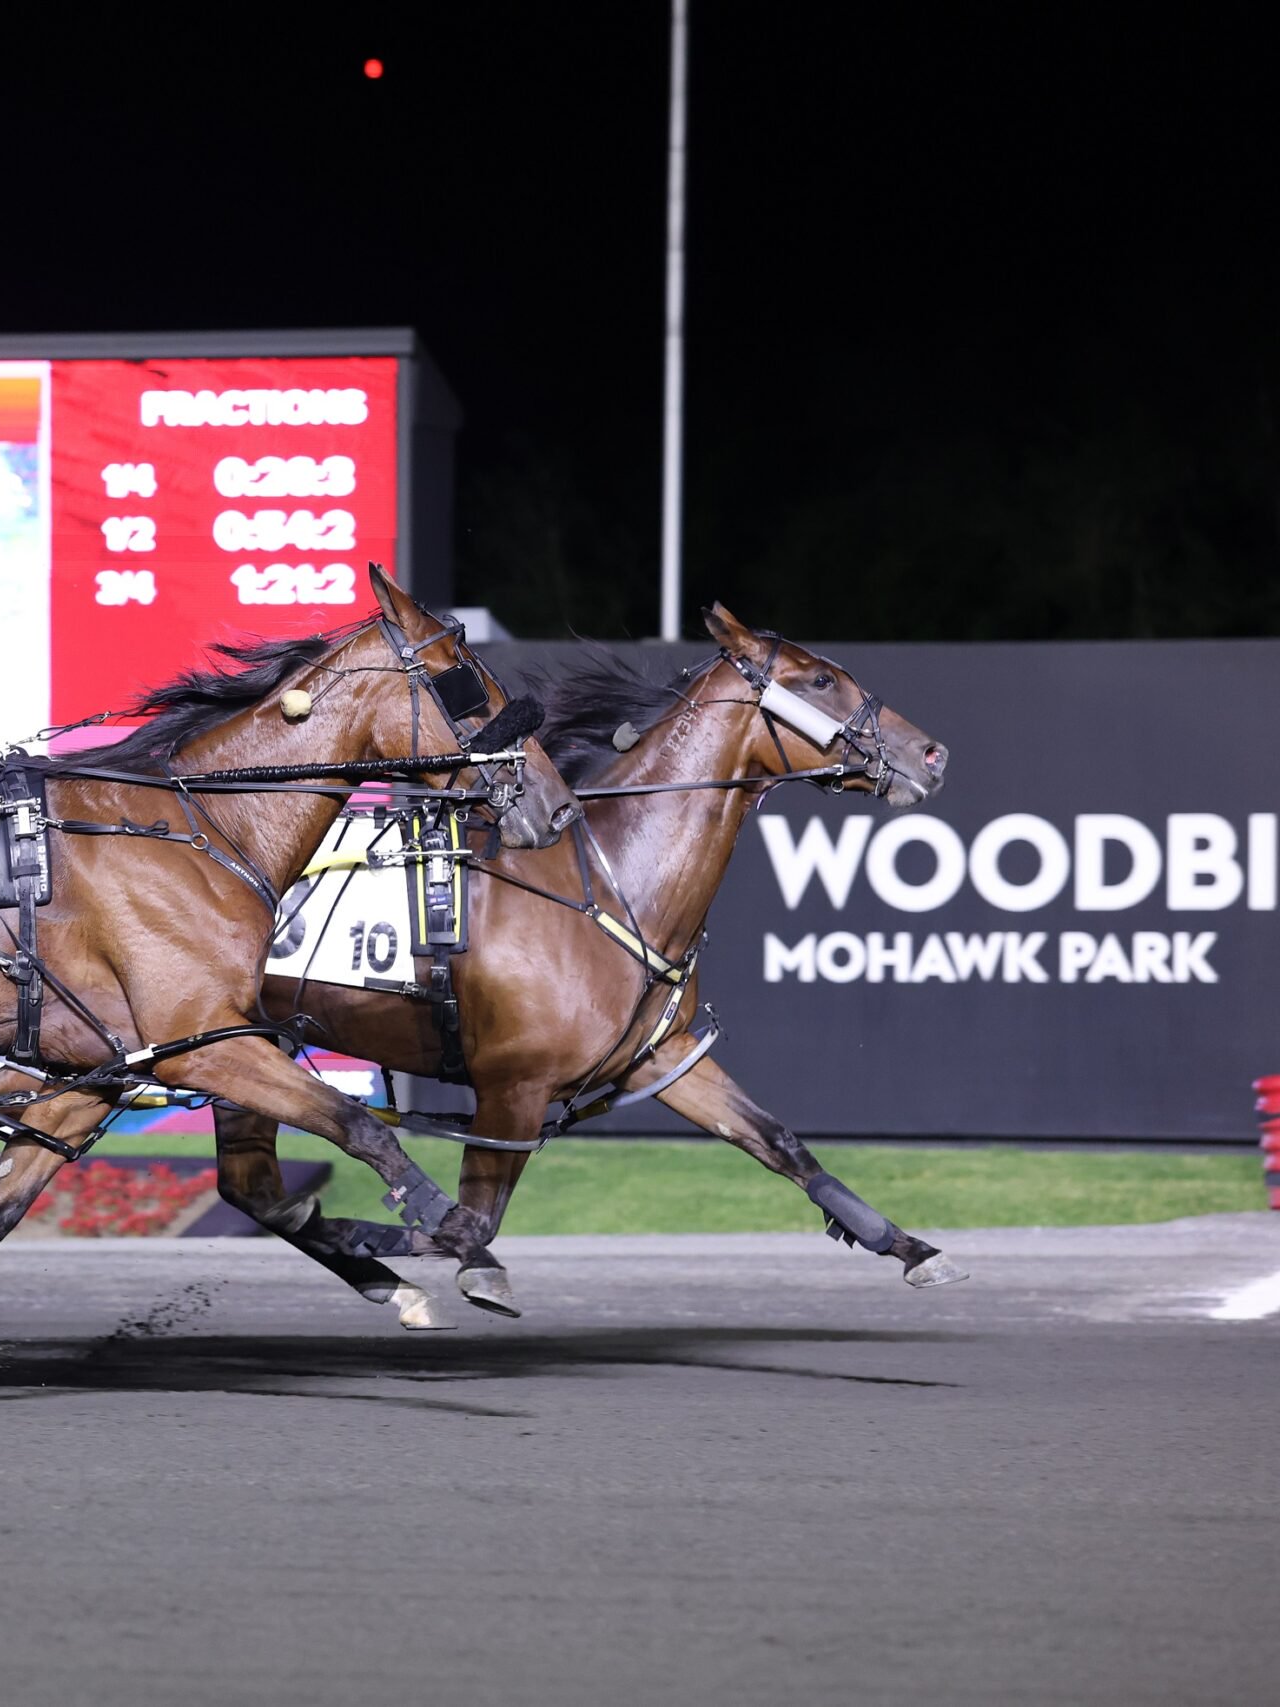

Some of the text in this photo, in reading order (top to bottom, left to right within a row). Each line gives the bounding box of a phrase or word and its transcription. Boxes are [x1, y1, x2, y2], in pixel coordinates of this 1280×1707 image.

[140, 388, 369, 427] FRACTIONS
[349, 920, 398, 973] 10
[763, 931, 1219, 984] MOHAWK PARK
